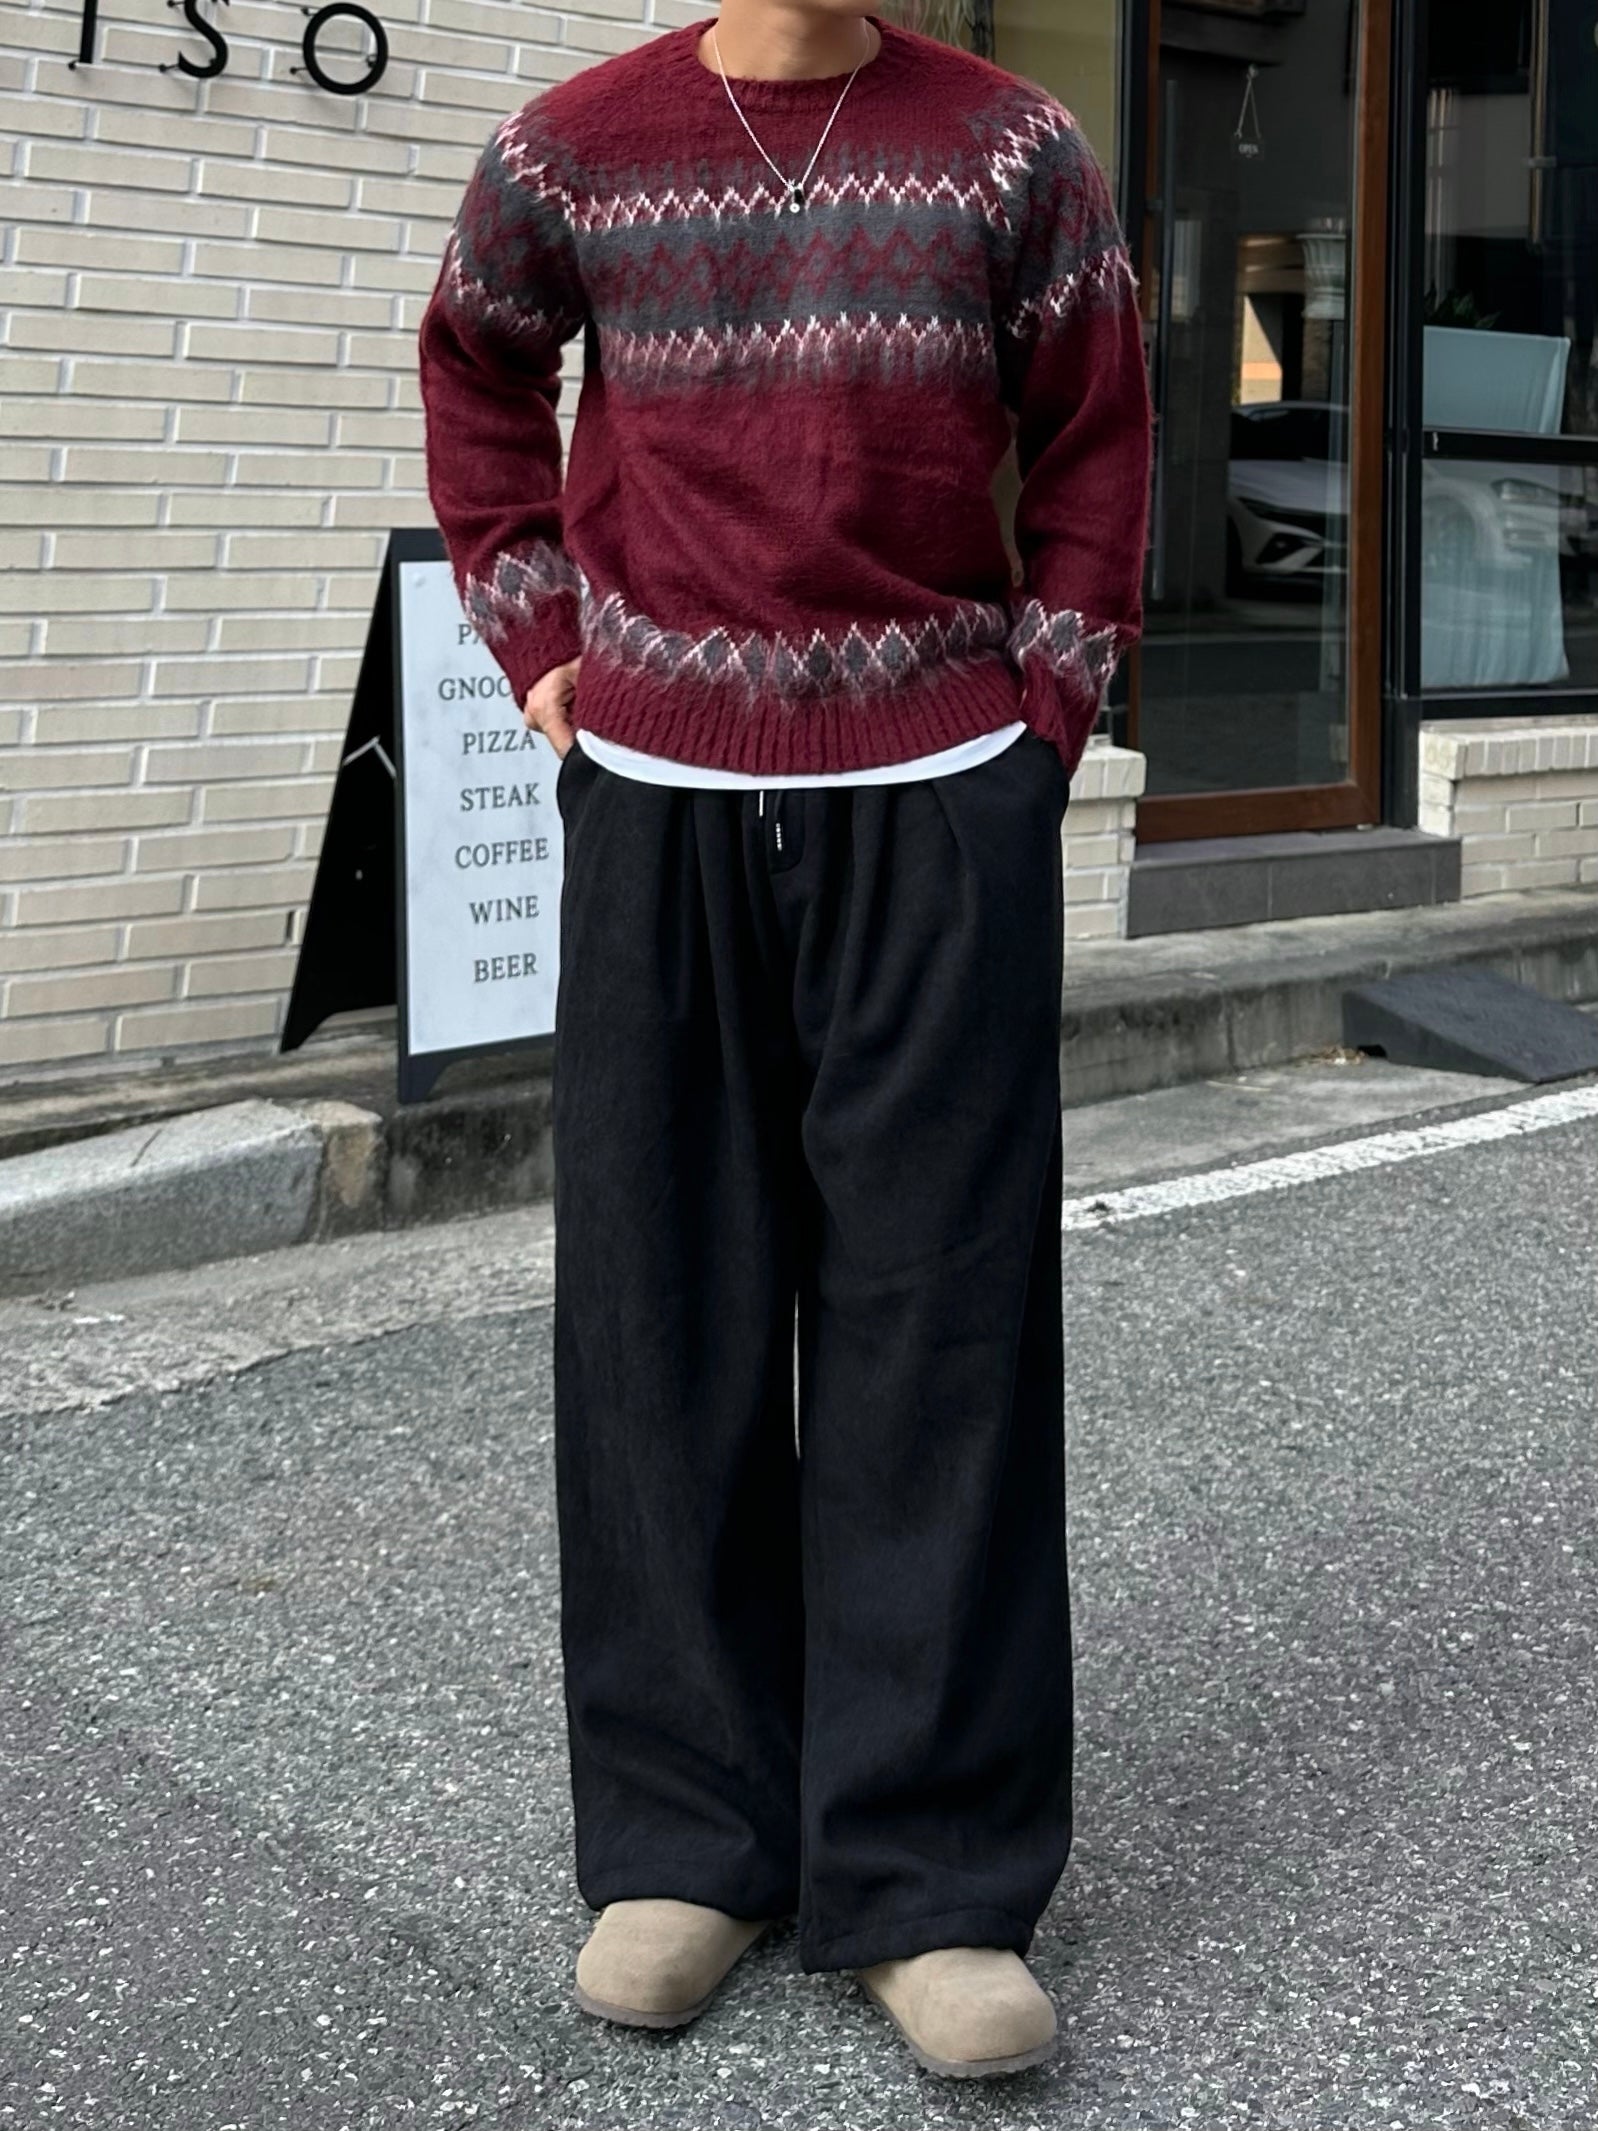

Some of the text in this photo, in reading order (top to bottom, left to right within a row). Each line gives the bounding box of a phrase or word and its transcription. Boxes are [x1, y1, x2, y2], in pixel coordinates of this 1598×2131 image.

[438, 675, 511, 701] GNOC
[462, 729, 537, 755] PIZZA
[460, 782, 541, 812] STEAK
[455, 837, 549, 869] COFFEE
[469, 894, 540, 924] WINE
[474, 952, 538, 983] BEER
